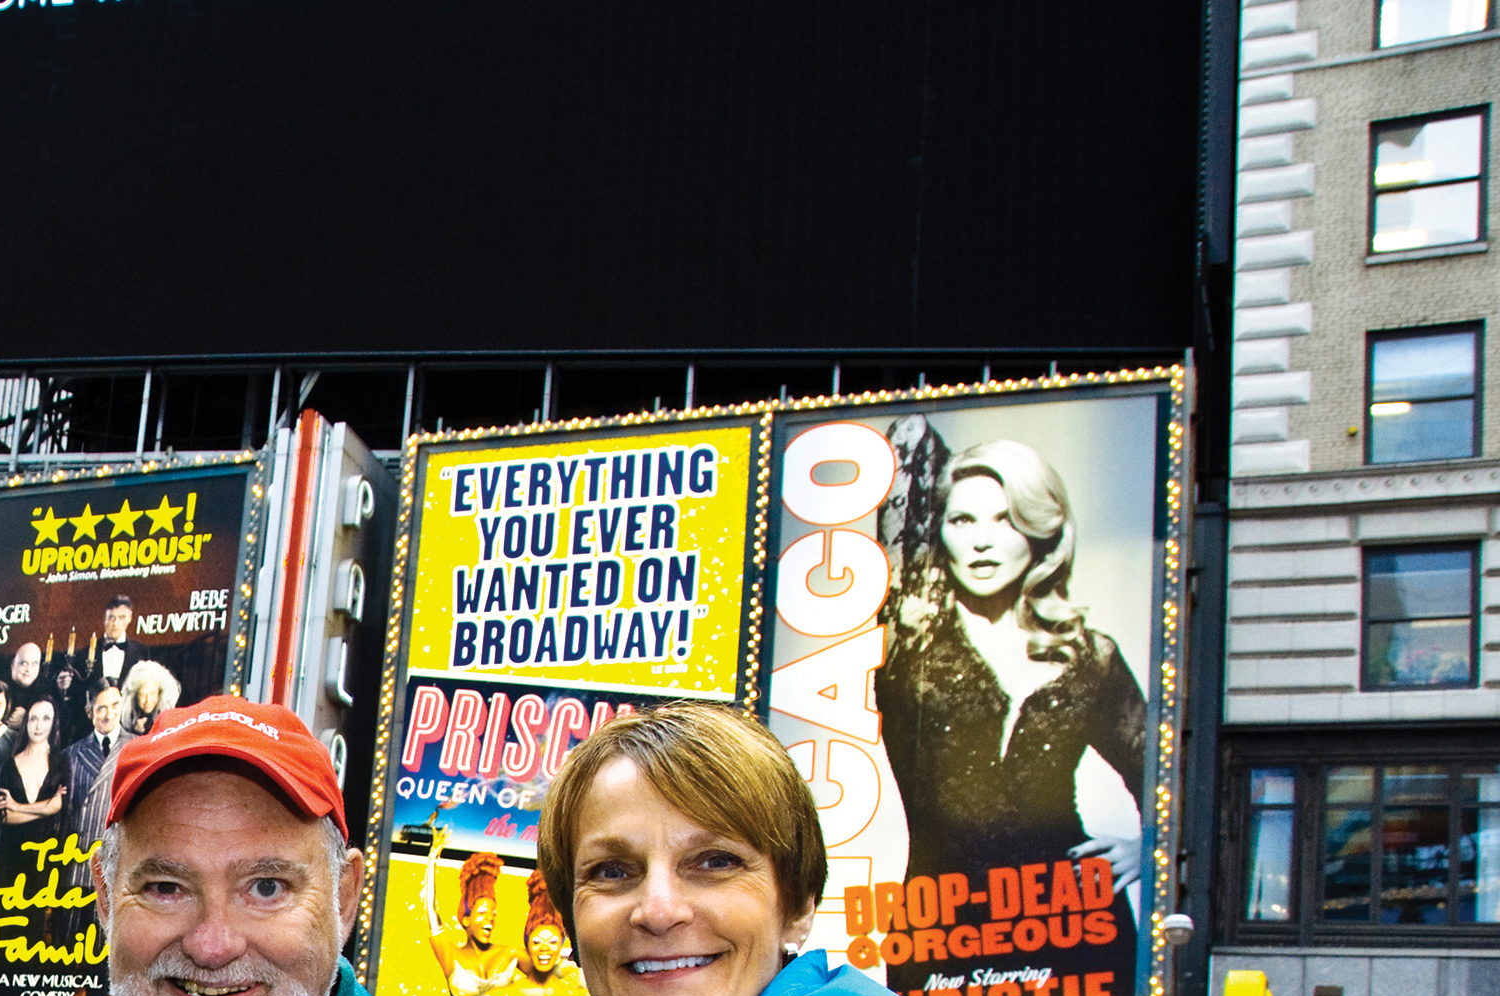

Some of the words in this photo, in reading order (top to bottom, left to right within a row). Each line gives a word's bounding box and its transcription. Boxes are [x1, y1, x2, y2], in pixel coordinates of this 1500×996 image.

[480, 512, 556, 561] YOU
[572, 504, 675, 555] EVER
[68, 570, 100, 582] Simon,
[100, 565, 150, 580] Bloomberg
[150, 563, 176, 575] News
[456, 560, 621, 614] WANTED
[638, 555, 696, 603] ON
[189, 589, 229, 611] BEBE
[136, 611, 228, 635] NEUWIRTH
[197, 711, 280, 741] SCHOLAR
[396, 777, 488, 806] QUEEN
[497, 787, 537, 810] OF
[484, 813, 517, 838] the
[844, 857, 1115, 937] DROP-DEAD
[846, 910, 1118, 969] GORGEOUS
[12, 974, 41, 987] NEW
[42, 974, 103, 989] MUSICAL
[924, 973, 966, 991] Now
[968, 966, 1053, 989] Starring
